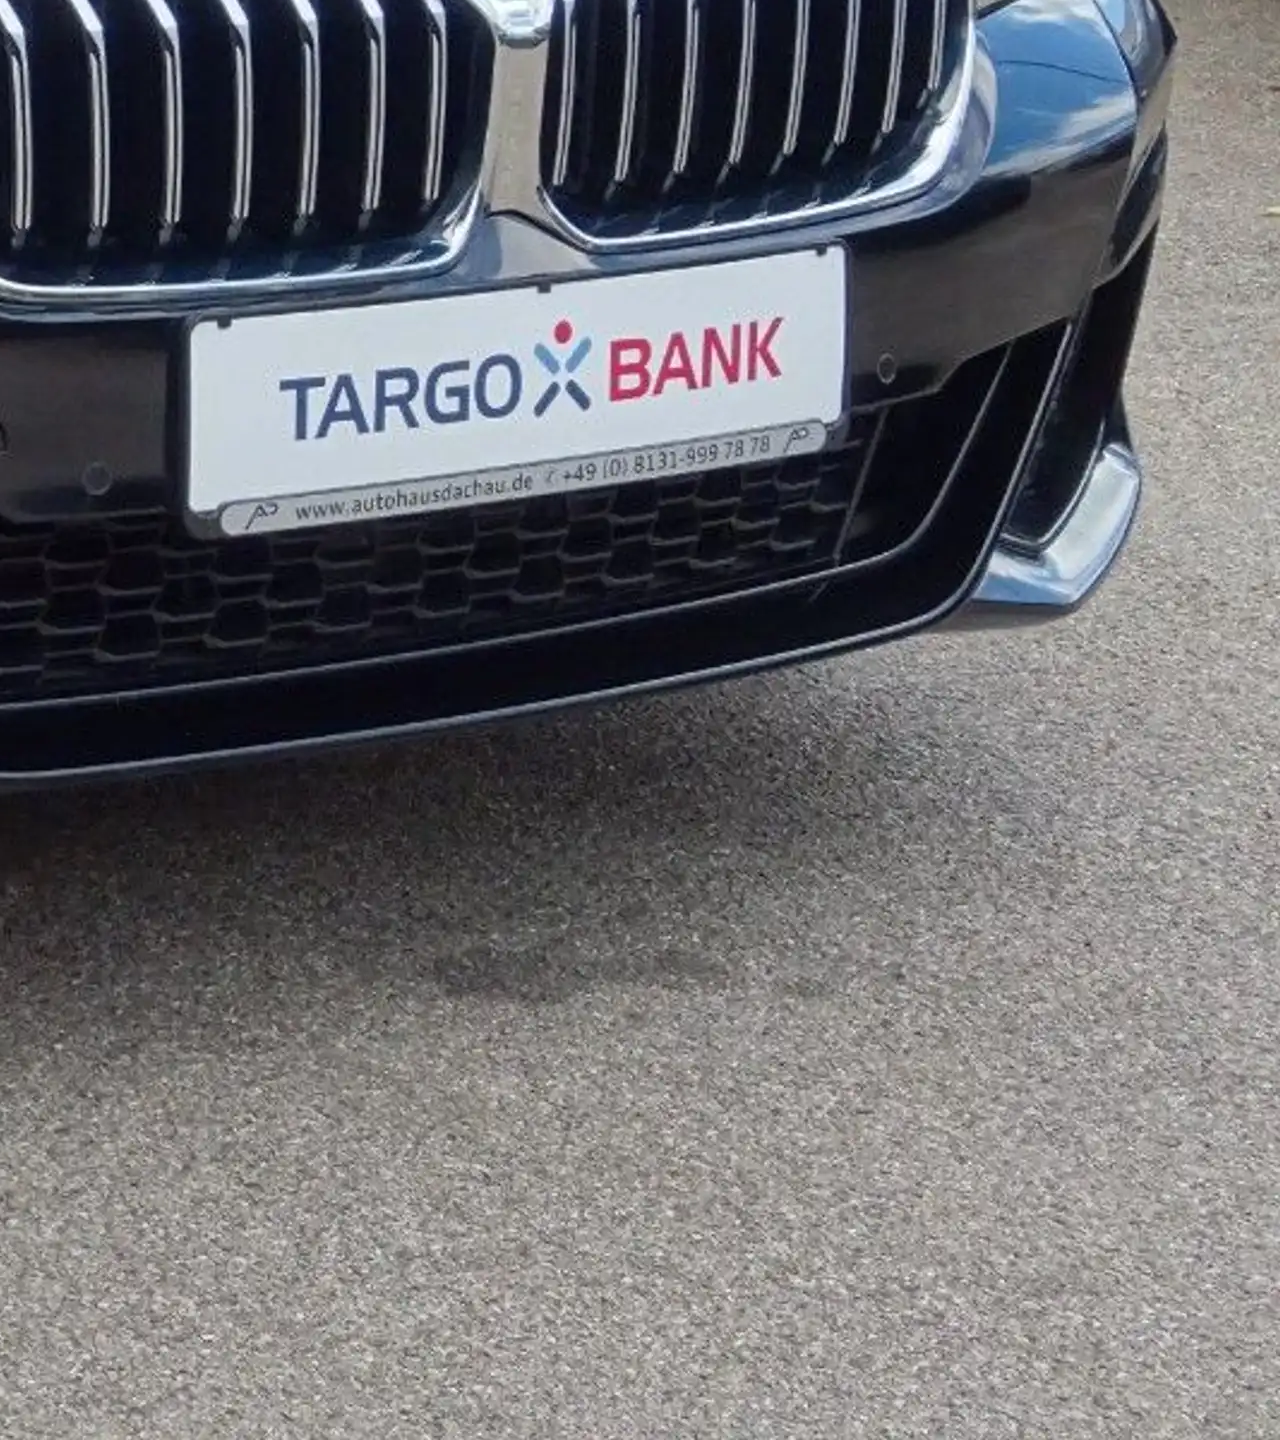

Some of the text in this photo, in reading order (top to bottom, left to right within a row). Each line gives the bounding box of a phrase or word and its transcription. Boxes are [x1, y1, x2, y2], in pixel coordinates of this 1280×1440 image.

[279, 317, 782, 441] TARGO BANK
[295, 471, 532, 520] www.autohausdachau.de
[564, 463, 597, 484] +49
[603, 459, 629, 480] (0)
[633, 444, 719, 473] 8131-999
[724, 440, 745, 461] 78
[750, 435, 771, 455] 78
